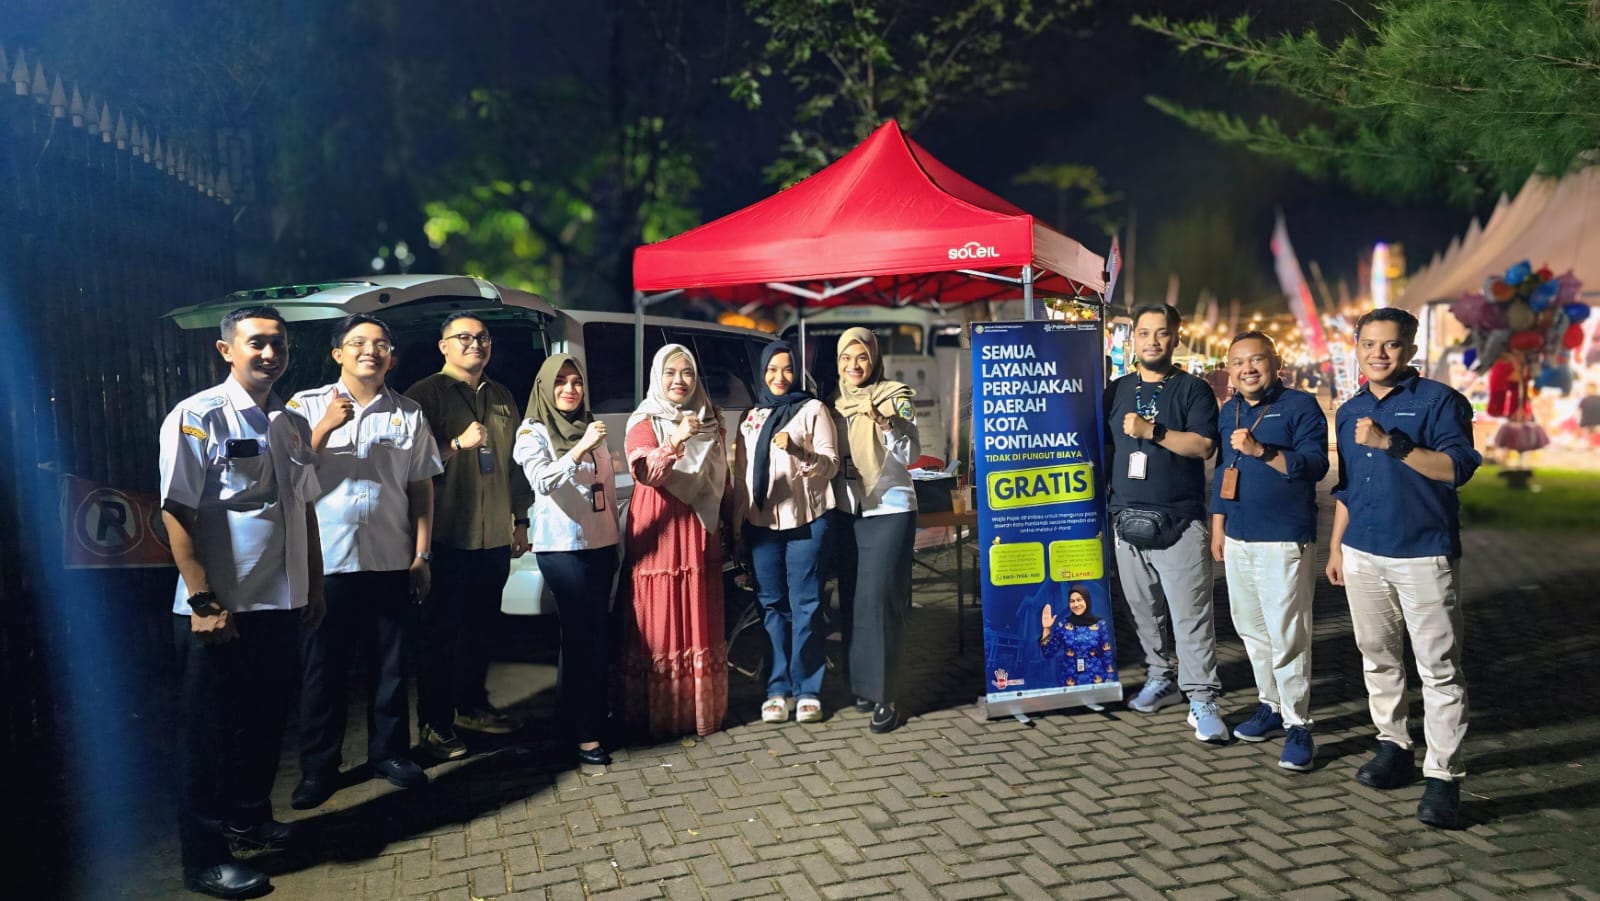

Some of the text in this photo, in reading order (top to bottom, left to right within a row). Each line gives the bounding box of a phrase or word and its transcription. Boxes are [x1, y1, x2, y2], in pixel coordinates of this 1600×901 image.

[982, 344, 1036, 360] SEMUA
[982, 361, 1057, 378] LAYANAN
[983, 379, 1083, 396] PERPAJAKAN
[984, 398, 1047, 414] DAERAH
[984, 417, 1028, 432] KOTA
[985, 432, 1078, 450] PONTIANAK
[985, 450, 1083, 463] TIDAK DI PUNGUT BIAYA
[994, 470, 1087, 500] GRATIS
